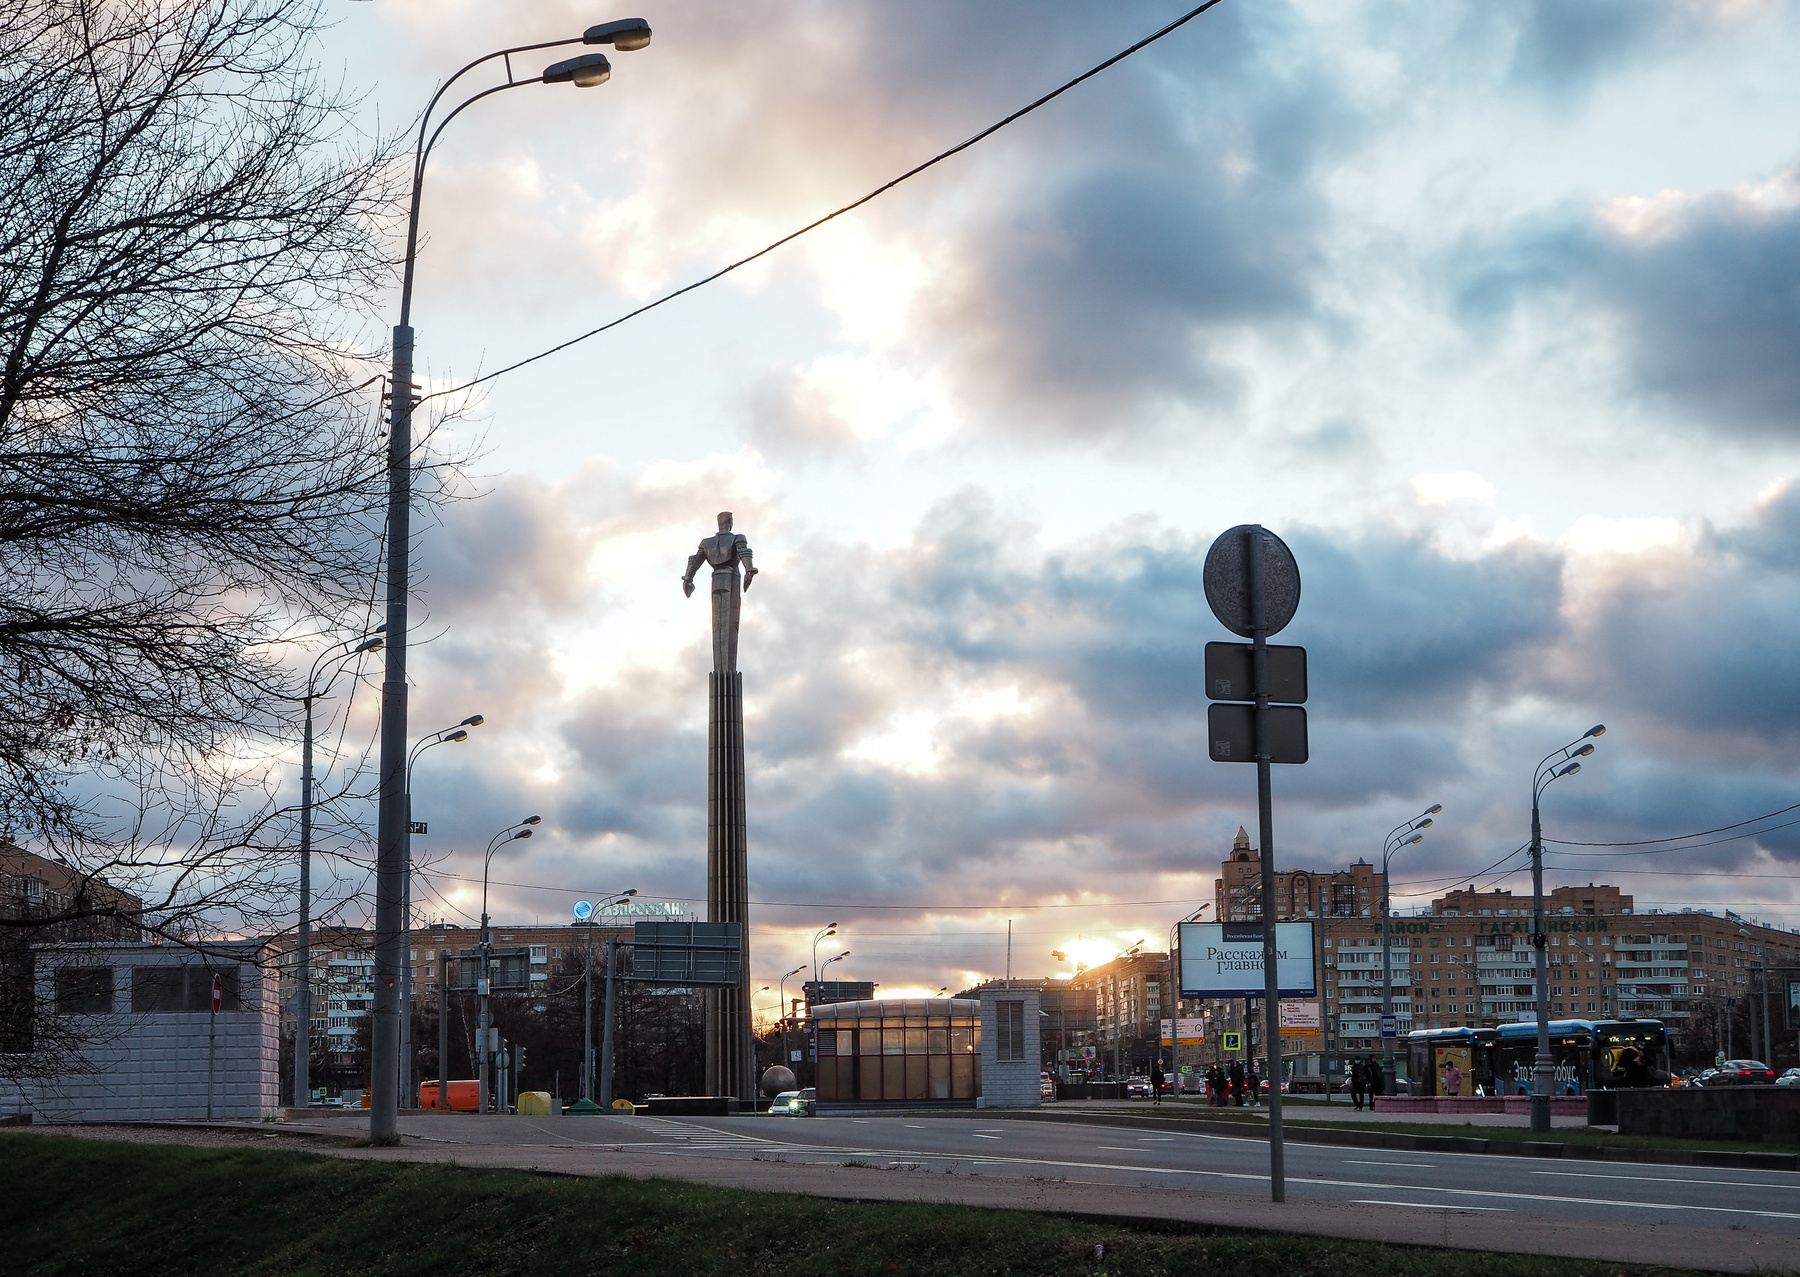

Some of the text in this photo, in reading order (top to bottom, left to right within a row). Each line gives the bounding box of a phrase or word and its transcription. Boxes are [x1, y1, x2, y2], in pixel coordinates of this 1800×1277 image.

[597, 902, 688, 916] ГАЗПРОМБАНК
[1479, 919, 1608, 933] ГАГАНСКИЙ
[1206, 947, 1288, 960] Расскажм
[1513, 1059, 1528, 1081] Это
